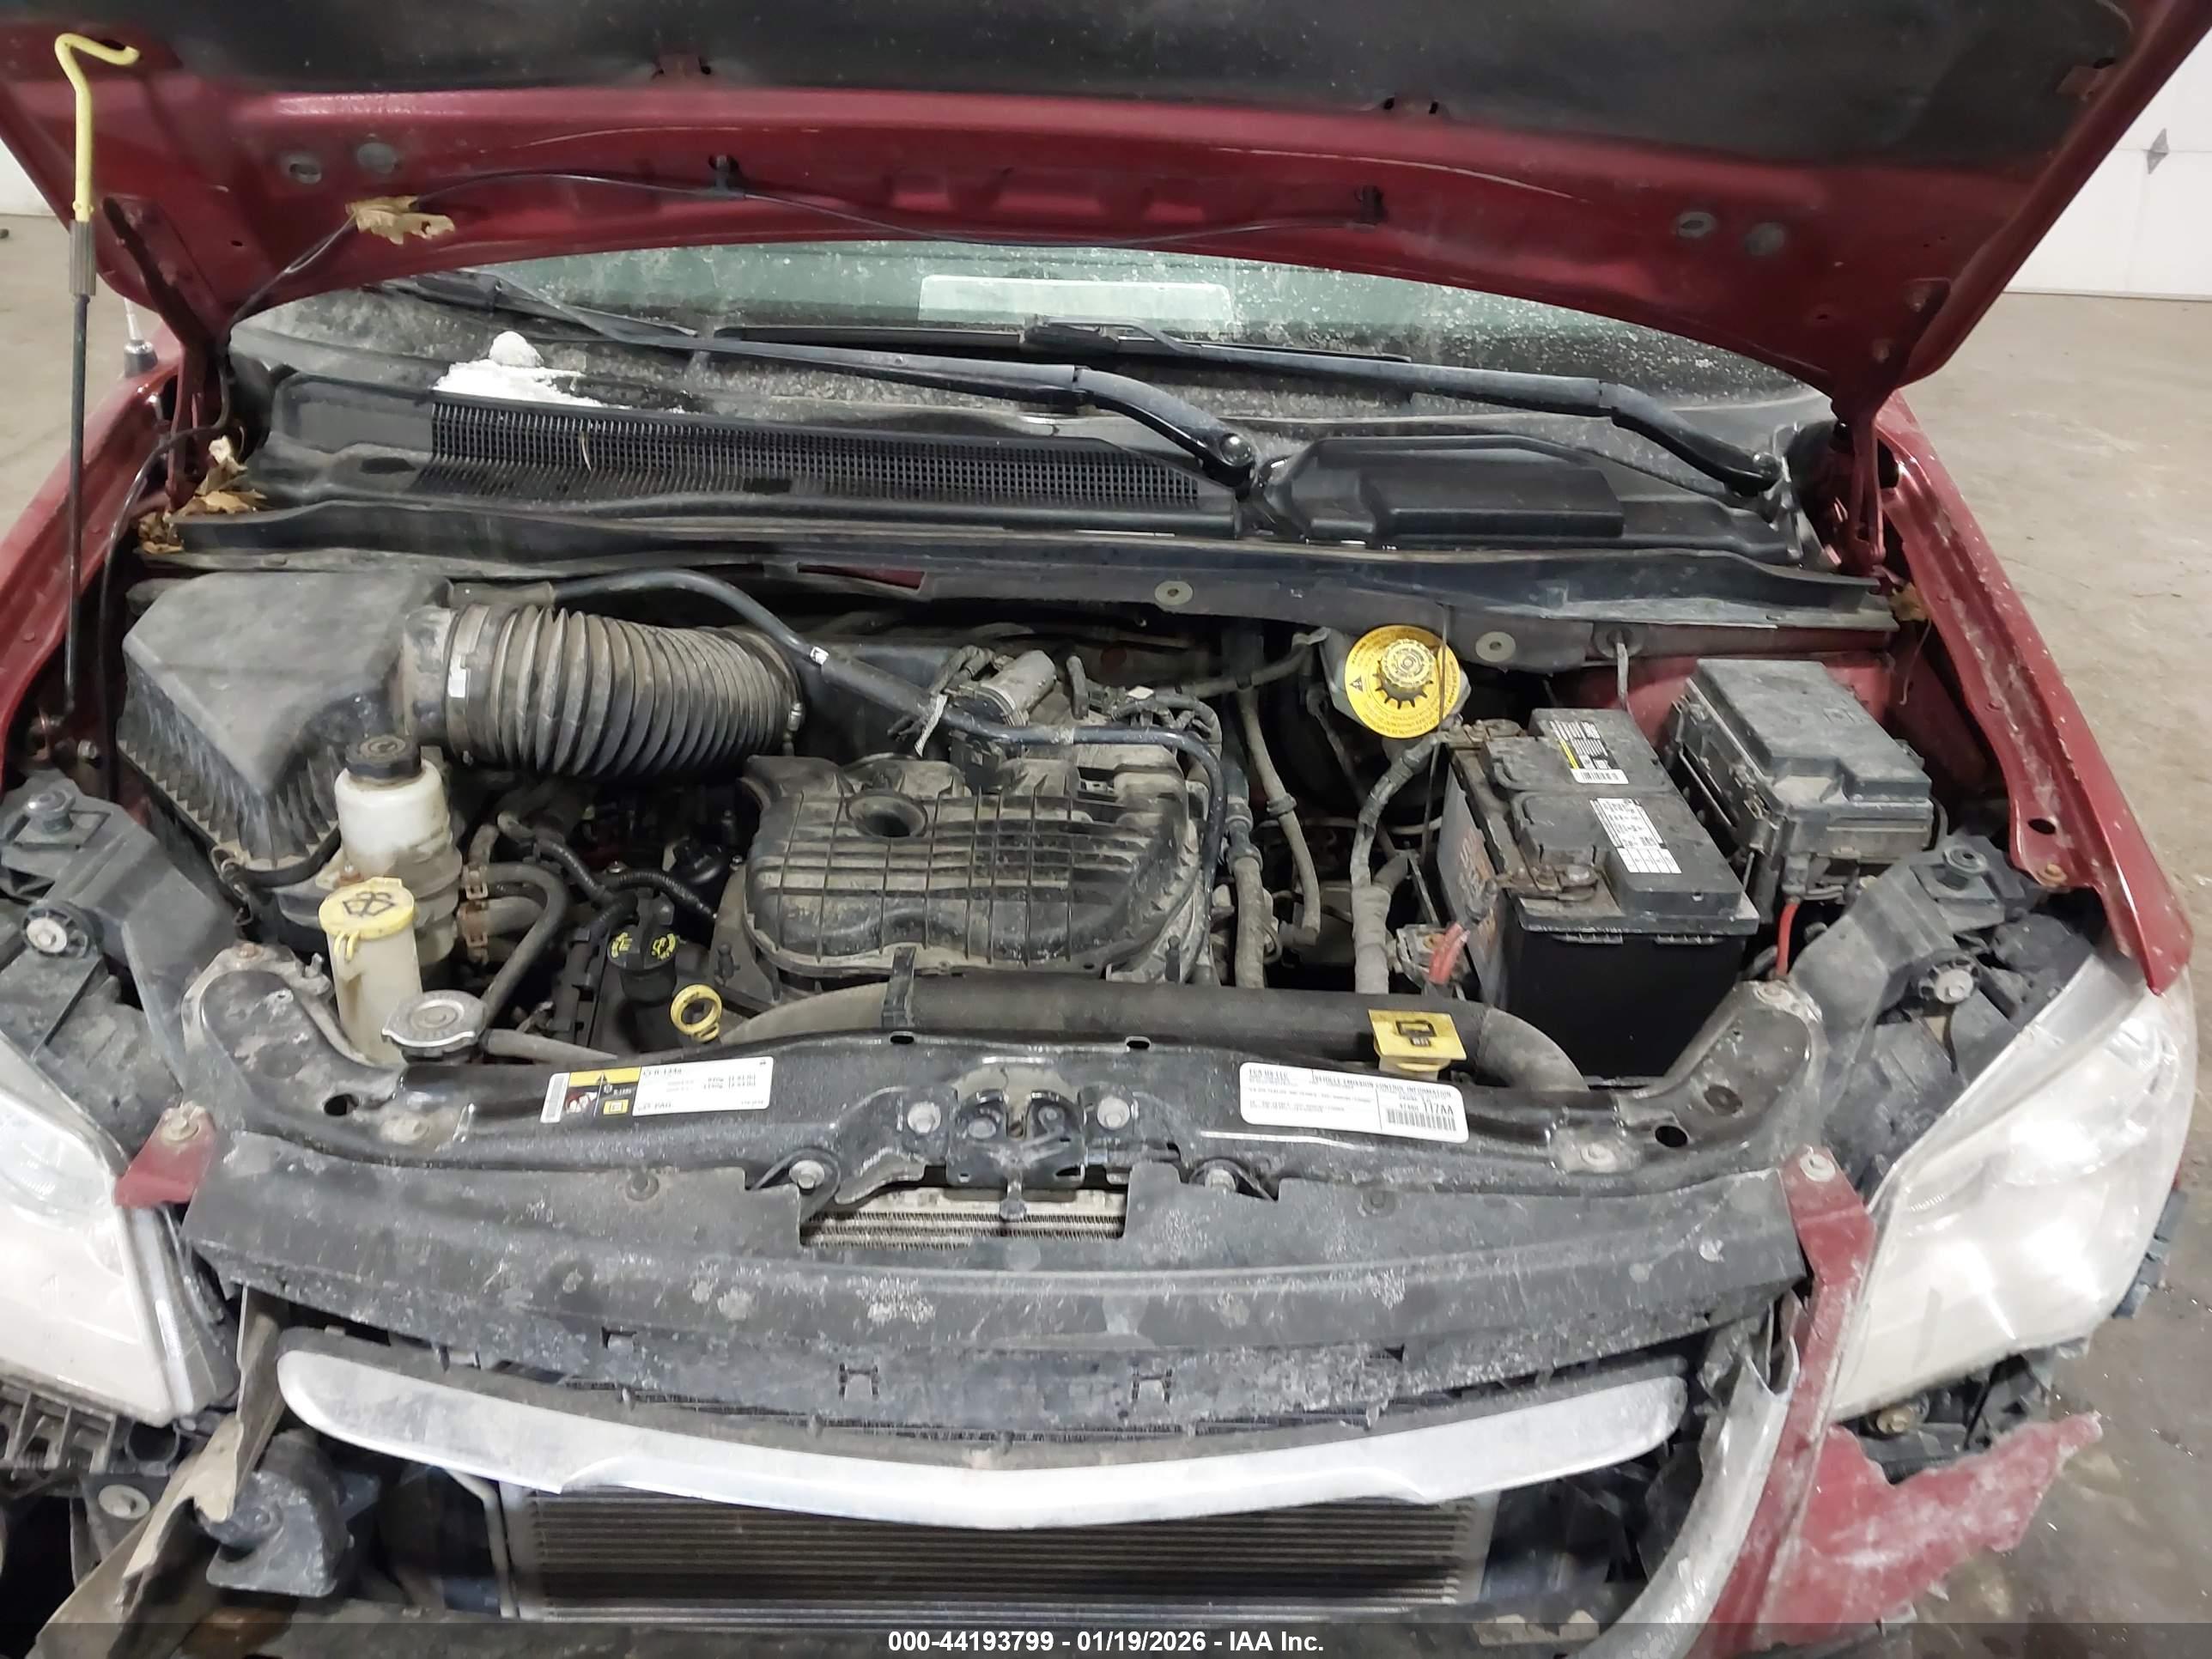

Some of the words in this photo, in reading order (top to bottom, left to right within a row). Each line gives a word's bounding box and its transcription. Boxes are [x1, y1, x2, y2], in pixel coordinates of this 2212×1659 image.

[1314, 1075, 1342, 1086] VEHICLE
[1343, 1078, 1374, 1089] EMISSION
[1376, 1082, 1405, 1093] CONTROL
[1407, 1084, 1452, 1098] INFORMATION
